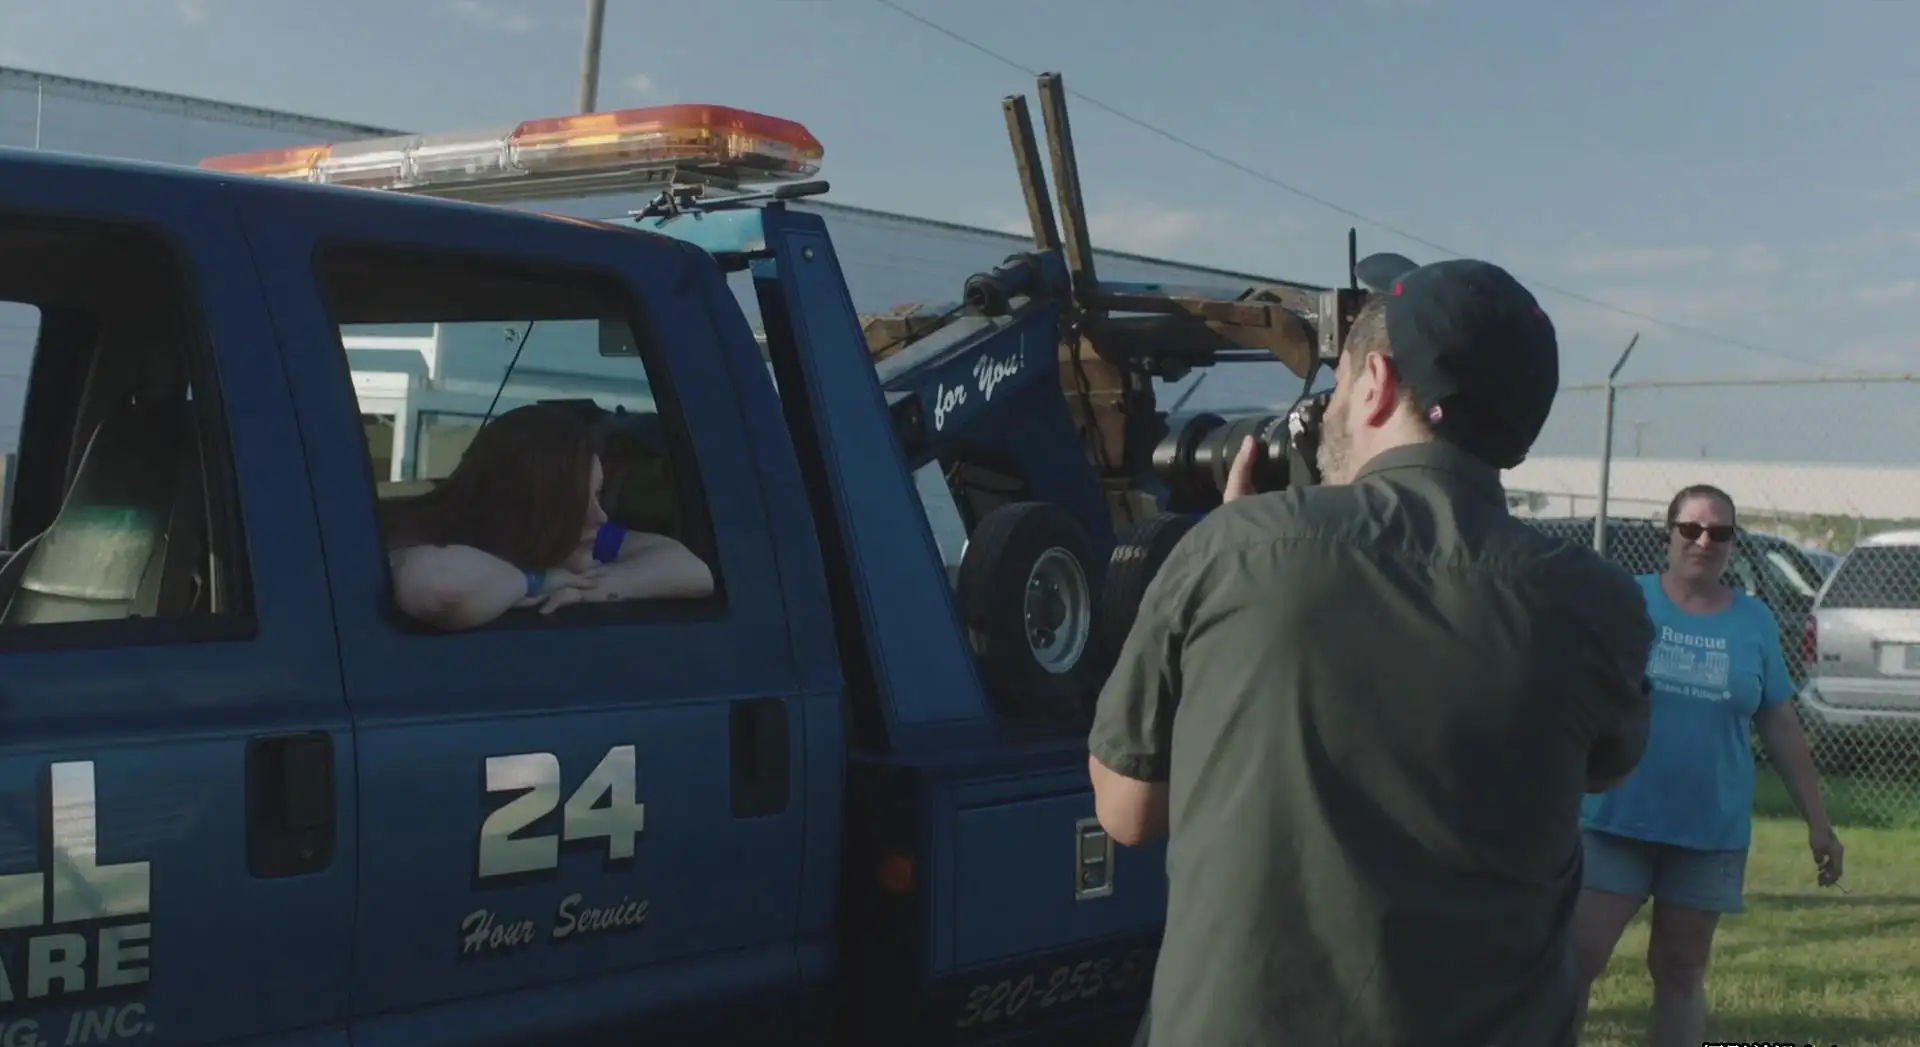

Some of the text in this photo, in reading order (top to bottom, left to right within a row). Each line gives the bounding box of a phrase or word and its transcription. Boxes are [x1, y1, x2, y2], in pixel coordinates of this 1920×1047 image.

[934, 332, 1025, 431] for You!
[1661, 625, 1727, 650] Rescue
[479, 744, 645, 878] 24
[461, 893, 649, 953] Hour Service
[64, 1001, 155, 1046] INC.
